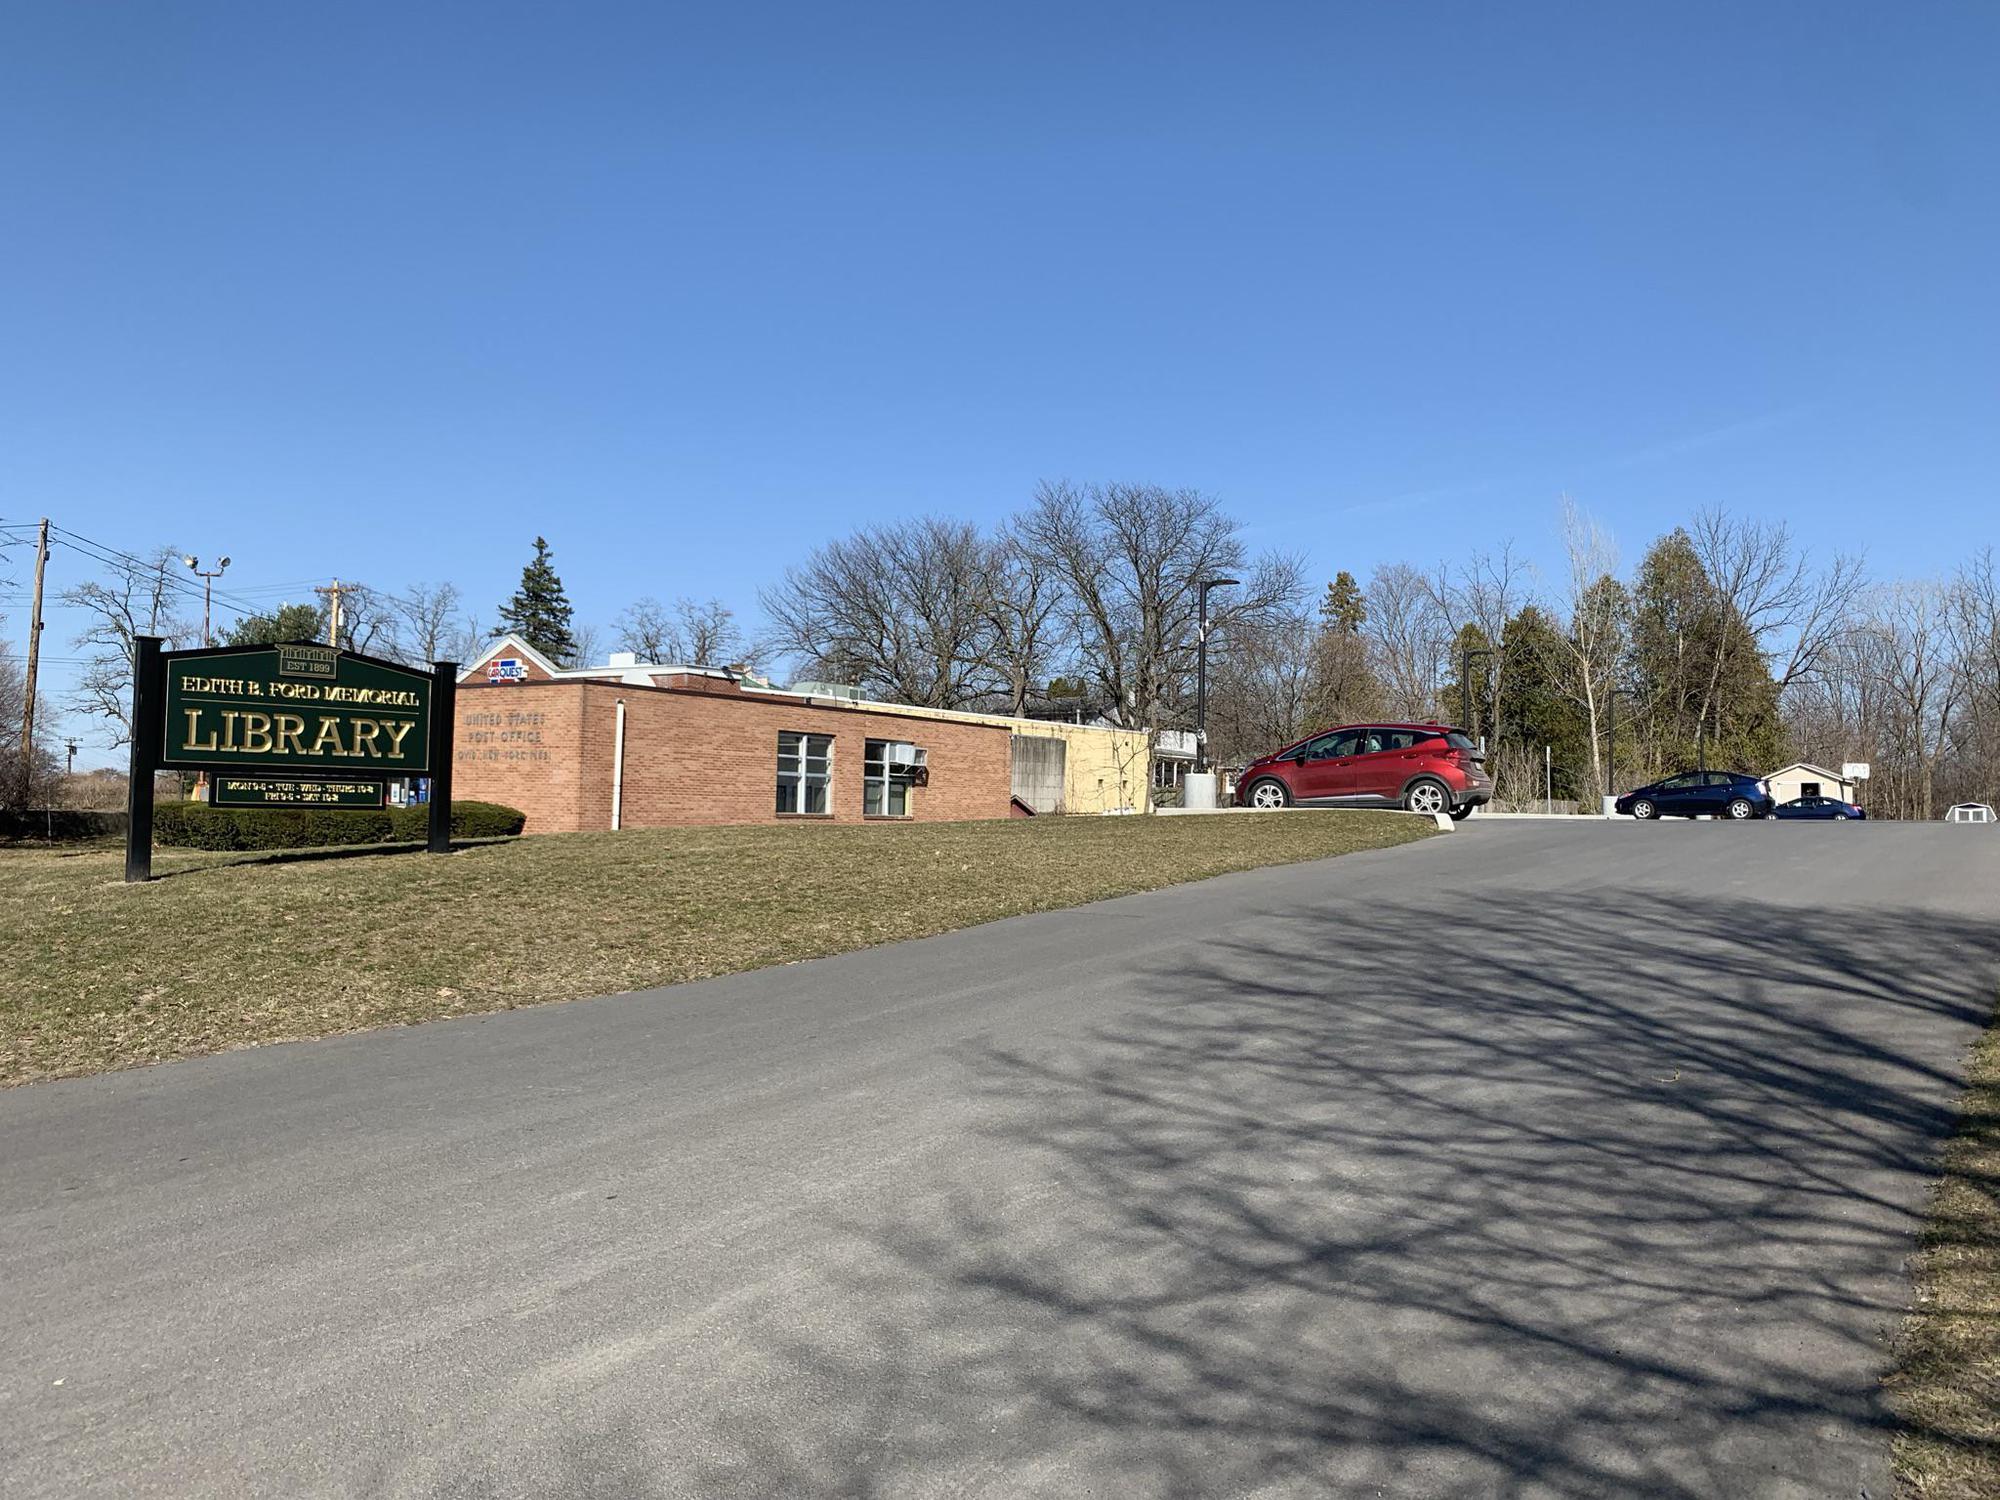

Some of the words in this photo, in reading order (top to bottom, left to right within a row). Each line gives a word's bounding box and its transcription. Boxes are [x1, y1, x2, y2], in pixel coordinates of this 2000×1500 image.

[287, 662, 307, 671] EST
[309, 663, 330, 673] 1899
[181, 676, 244, 693] EDITH
[268, 681, 320, 700] FORD
[324, 686, 420, 707] MEMORIAL
[463, 713, 502, 726] UNITED
[508, 712, 545, 725] STATES
[182, 708, 416, 759] LIBRARY
[468, 731, 495, 742] POST
[500, 731, 541, 742] OFFICE
[227, 782, 252, 790] MON
[276, 783, 295, 792] TUE
[300, 783, 322, 792] WED
[326, 784, 355, 793] THURS
[265, 792, 279, 800] FRI
[302, 793, 320, 801] SAT
